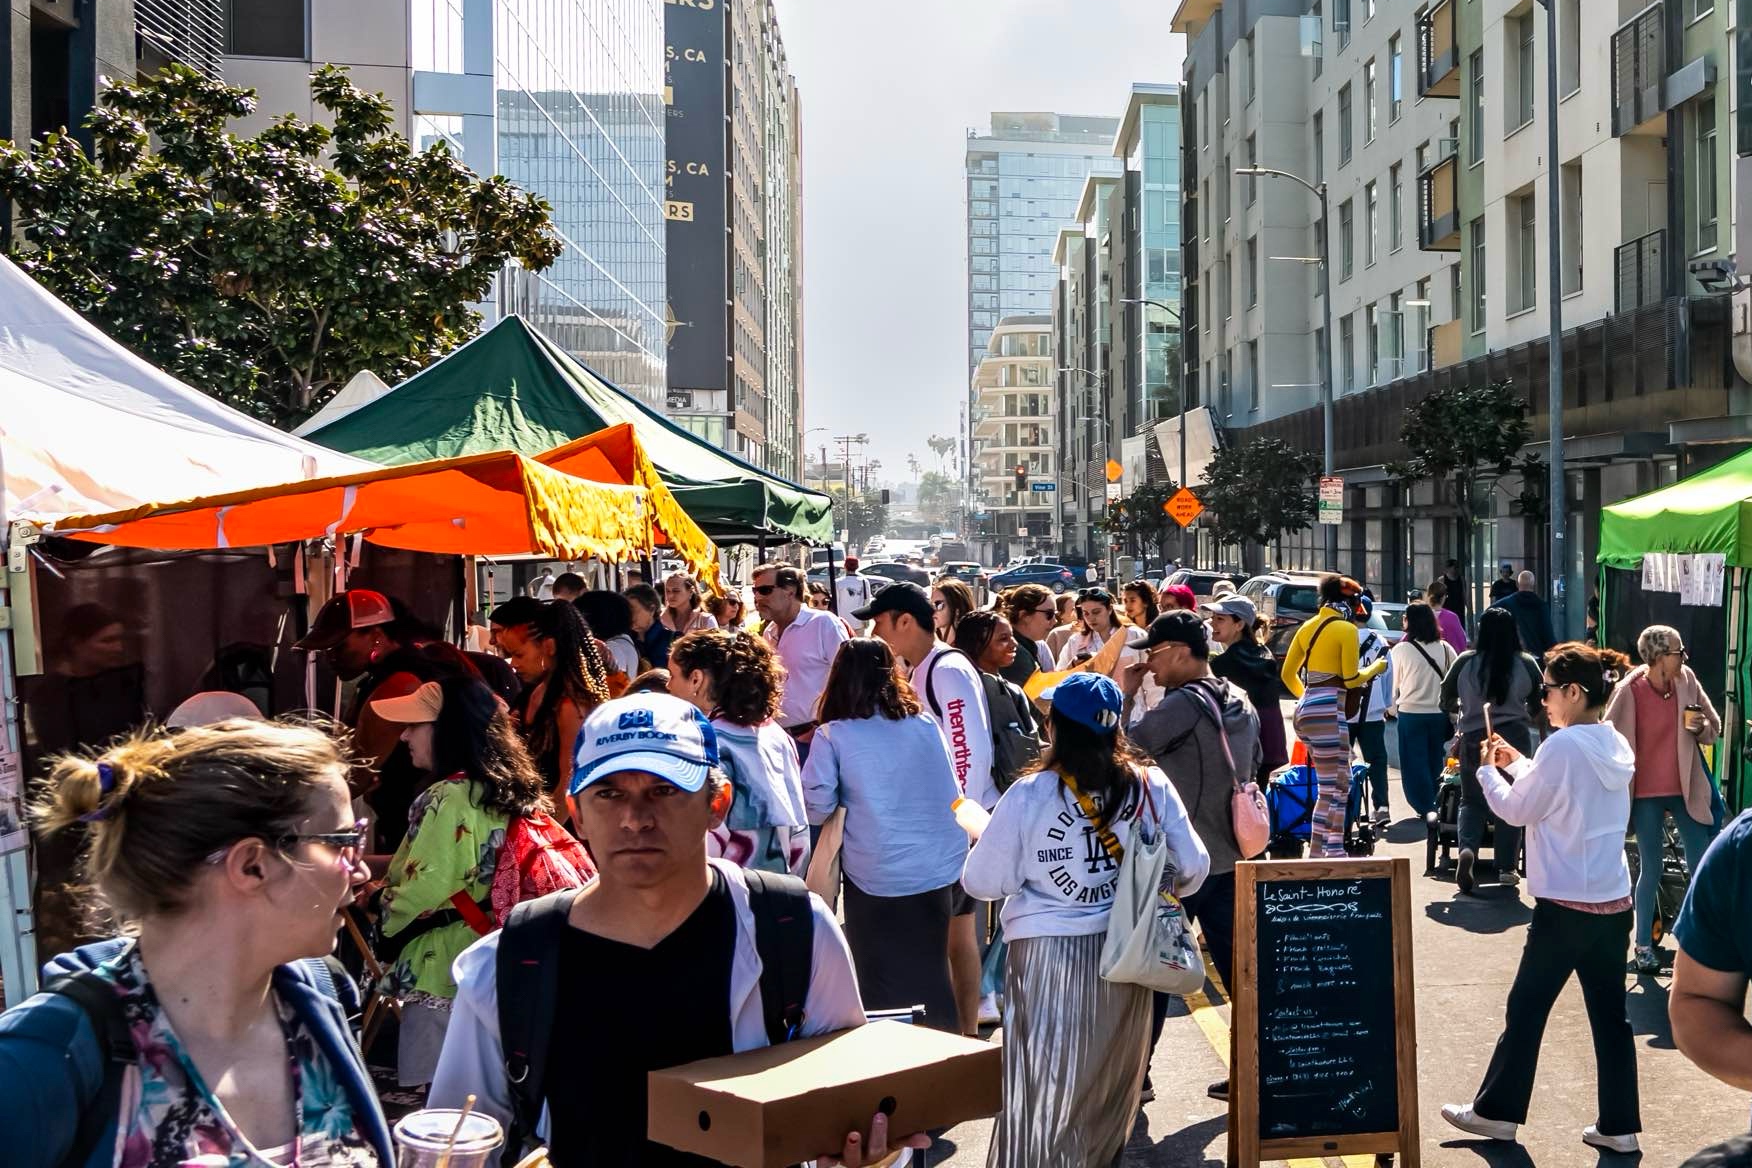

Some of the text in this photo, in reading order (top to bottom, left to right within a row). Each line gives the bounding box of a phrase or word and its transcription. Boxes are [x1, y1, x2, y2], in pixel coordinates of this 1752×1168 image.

[684, 48, 706, 63] CA
[686, 162, 710, 176] CA
[596, 730, 678, 746] RIVERBY BOOKS
[1037, 847, 1074, 863] SINCE
[1048, 865, 1079, 897] LOS
